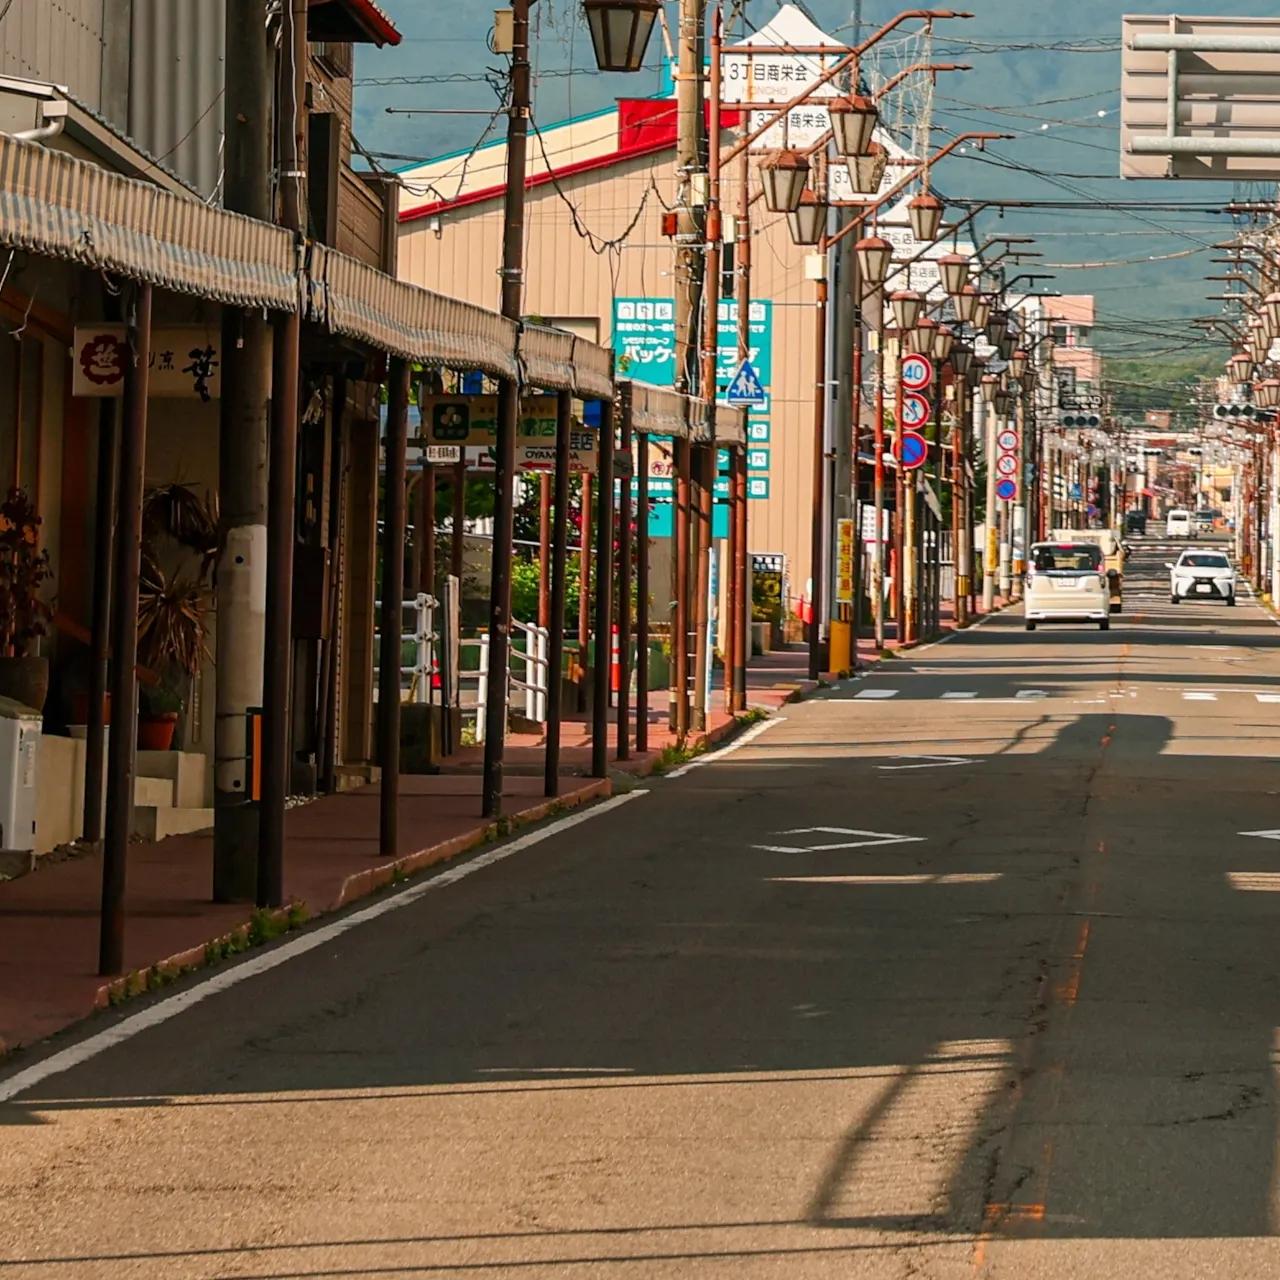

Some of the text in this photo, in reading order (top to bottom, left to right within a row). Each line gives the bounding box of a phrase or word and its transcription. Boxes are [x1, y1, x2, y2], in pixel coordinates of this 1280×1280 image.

[730, 63, 807, 82] 3丁目商栄会
[904, 365, 924, 380] 40
